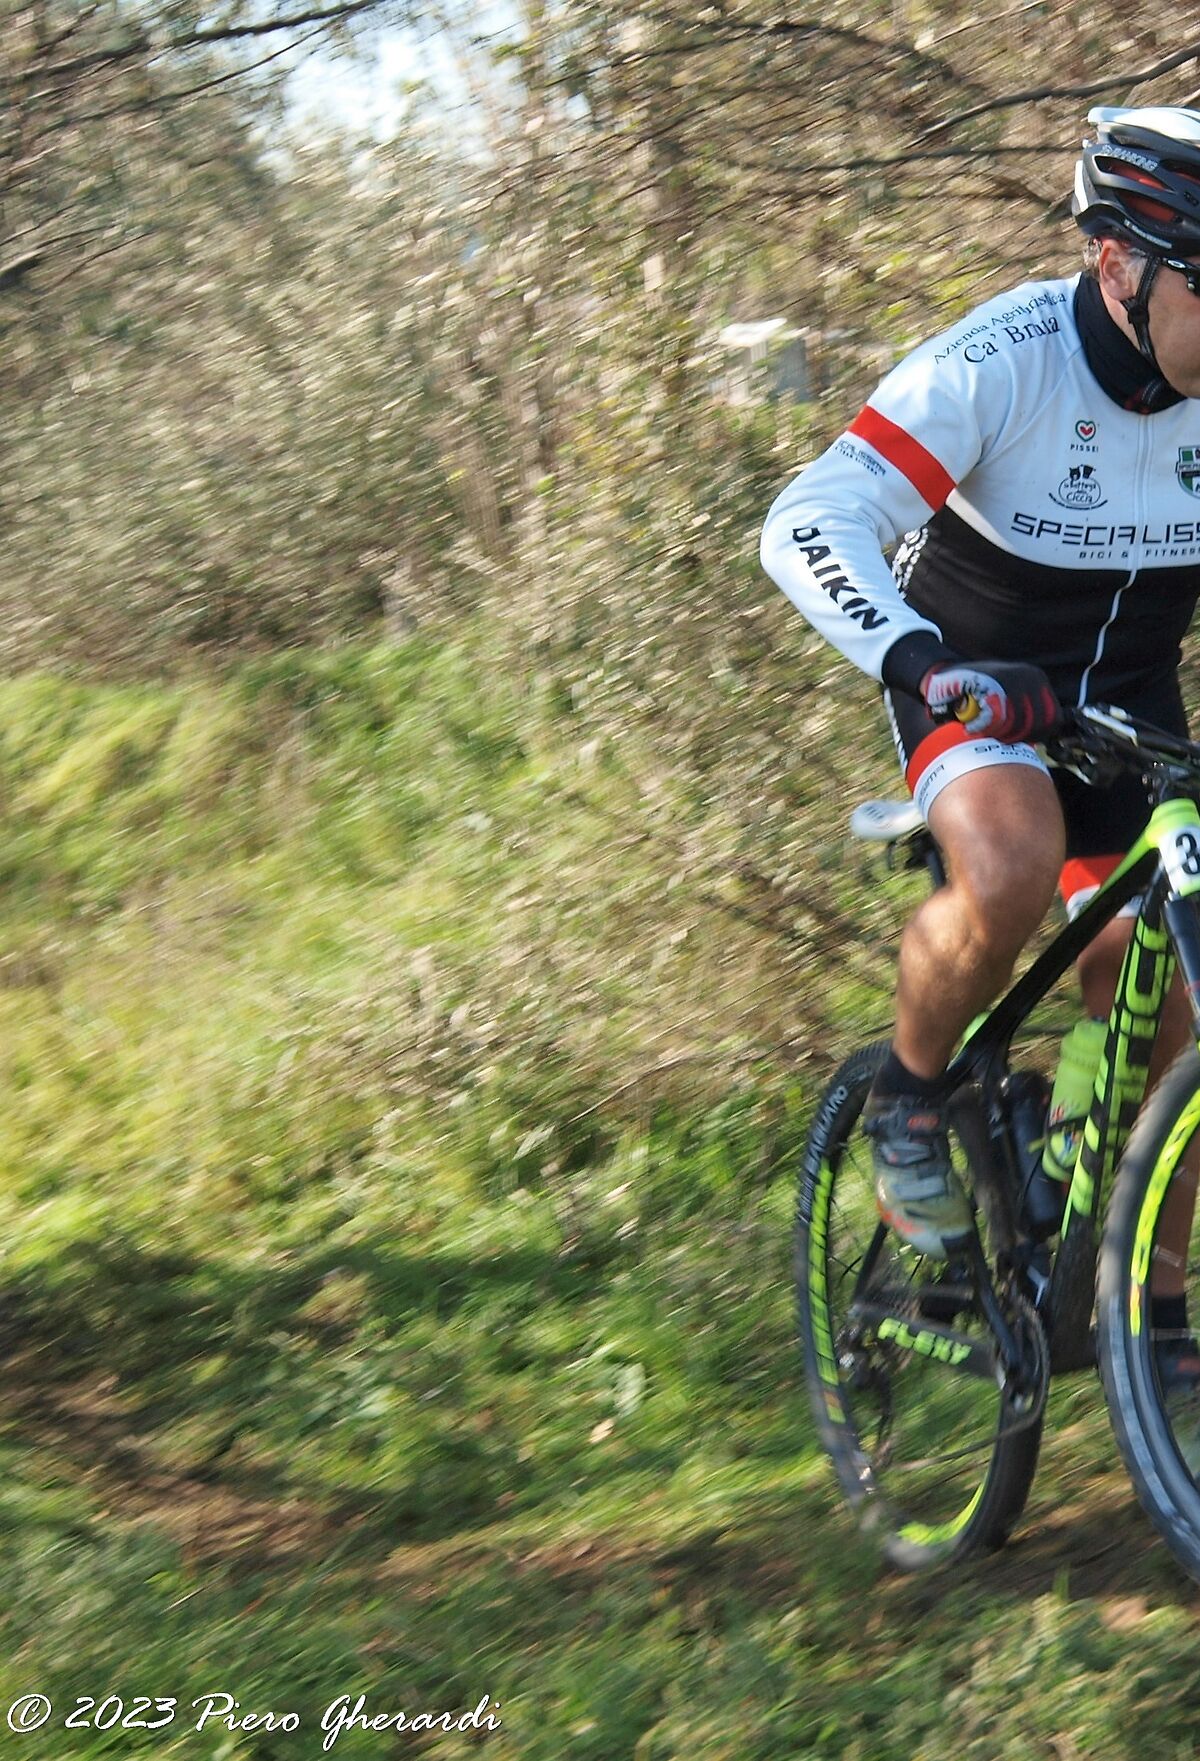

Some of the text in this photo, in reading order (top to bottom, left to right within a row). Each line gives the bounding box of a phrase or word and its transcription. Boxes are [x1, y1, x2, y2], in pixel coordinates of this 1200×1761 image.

[1070, 443, 1099, 453] PISSEI
[1079, 551, 1112, 559] BICI
[792, 527, 890, 631] DAIKIN
